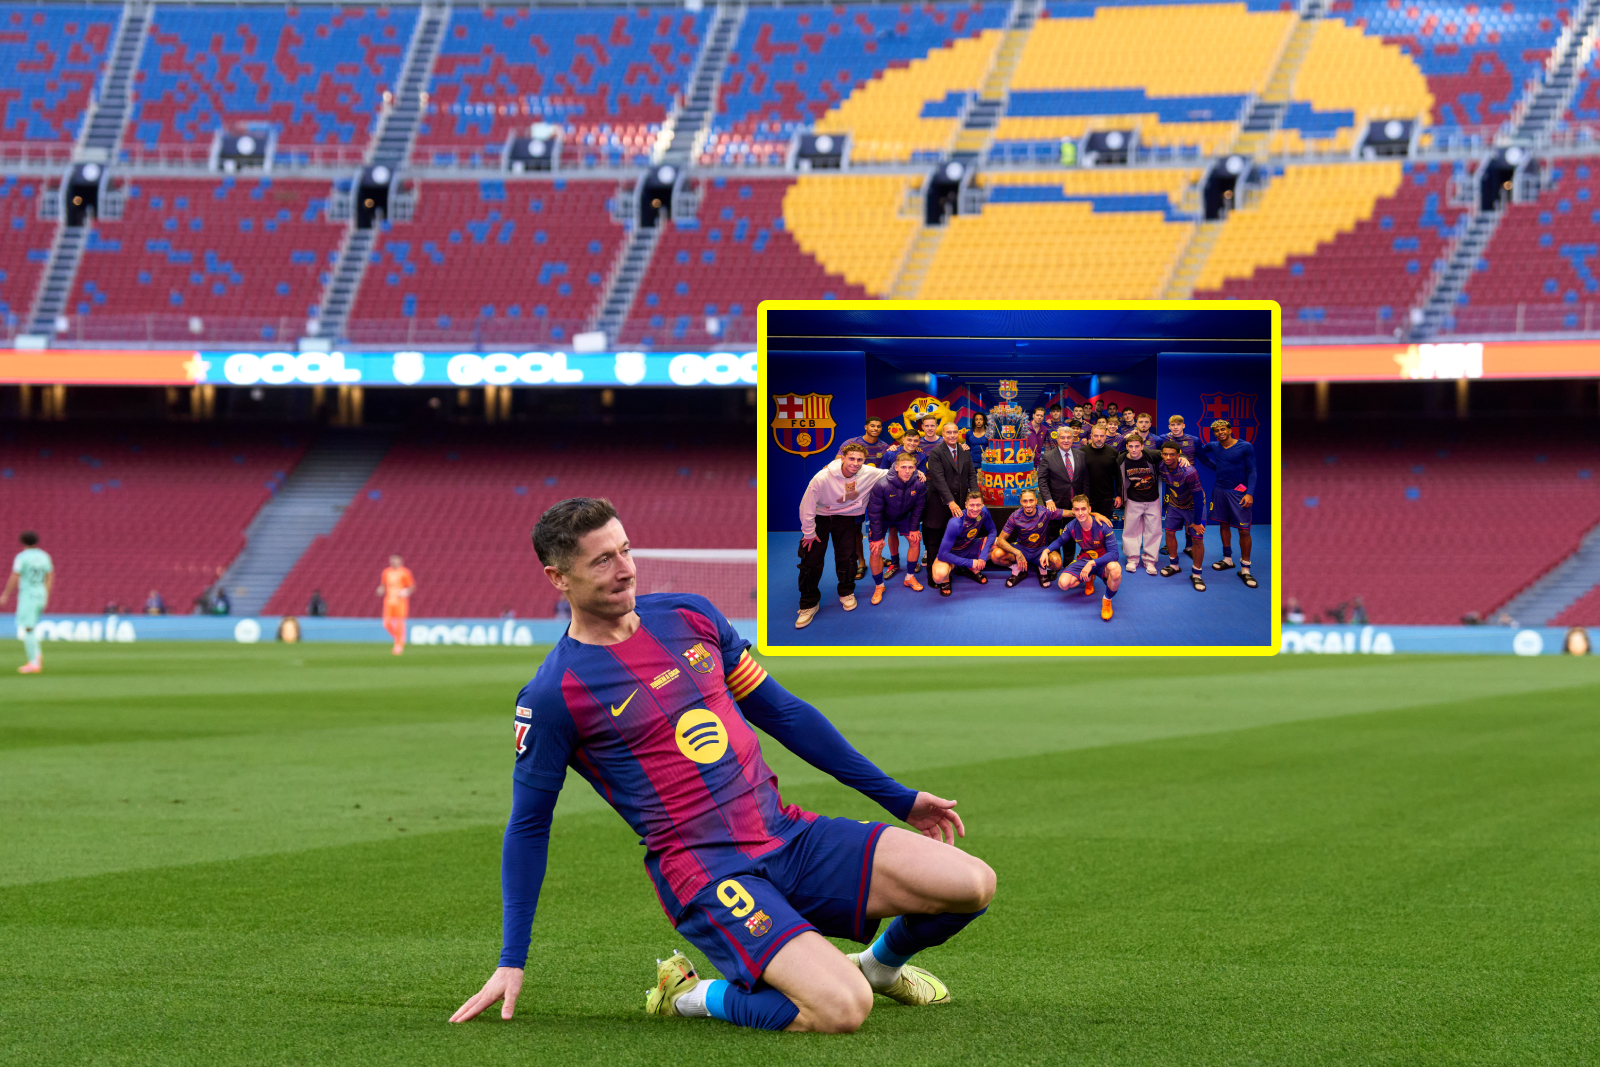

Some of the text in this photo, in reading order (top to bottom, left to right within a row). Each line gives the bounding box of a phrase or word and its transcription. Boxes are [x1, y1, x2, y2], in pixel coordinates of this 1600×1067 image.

[224, 352, 757, 386] GOOL GOOL GOO
[791, 419, 816, 428] FCB
[994, 447, 1027, 464] 126
[984, 472, 1034, 489] BARÇA
[1281, 626, 1394, 654] OSALÍA
[716, 879, 755, 918] 9
